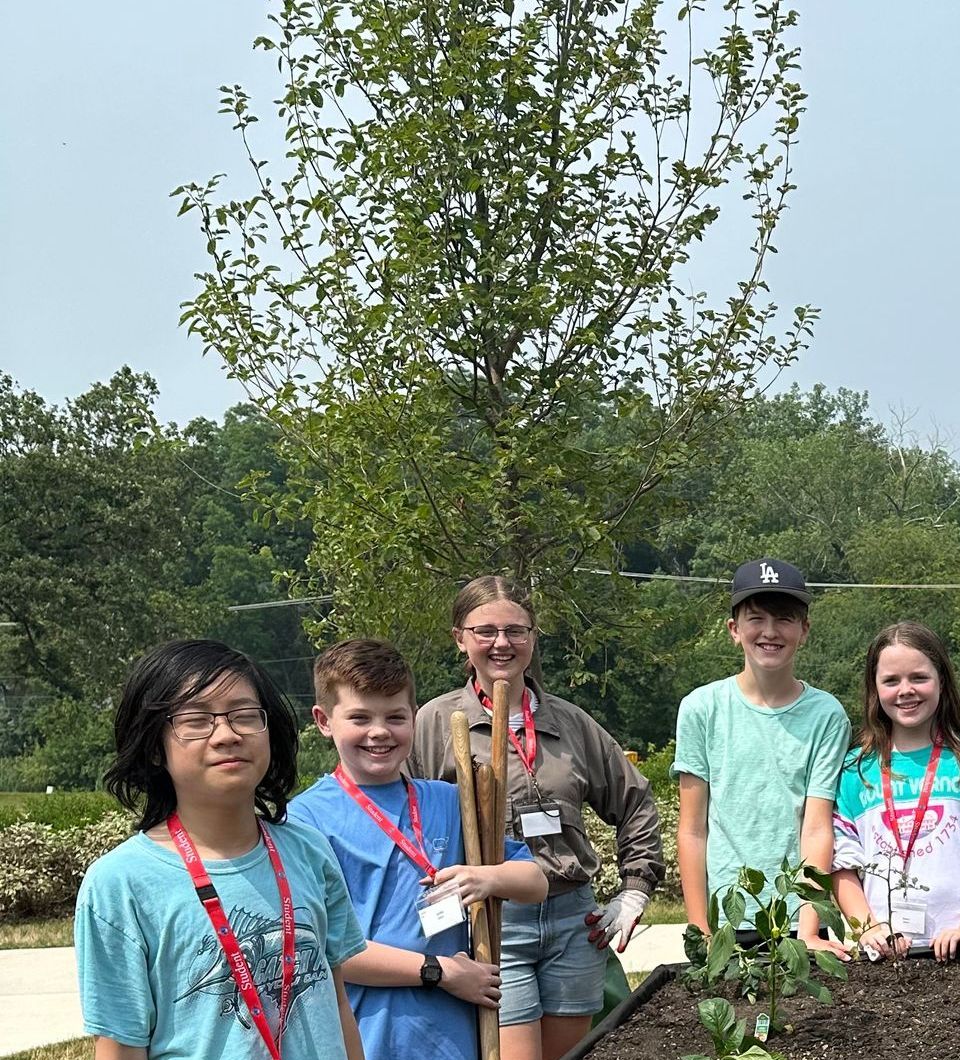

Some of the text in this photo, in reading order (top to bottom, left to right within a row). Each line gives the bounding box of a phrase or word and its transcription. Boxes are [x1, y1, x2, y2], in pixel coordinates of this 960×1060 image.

[759, 562, 779, 584] LA
[365, 803, 384, 823] Student
[174, 828, 198, 864] Student
[283, 896, 293, 935] Student
[230, 950, 253, 991] Student
